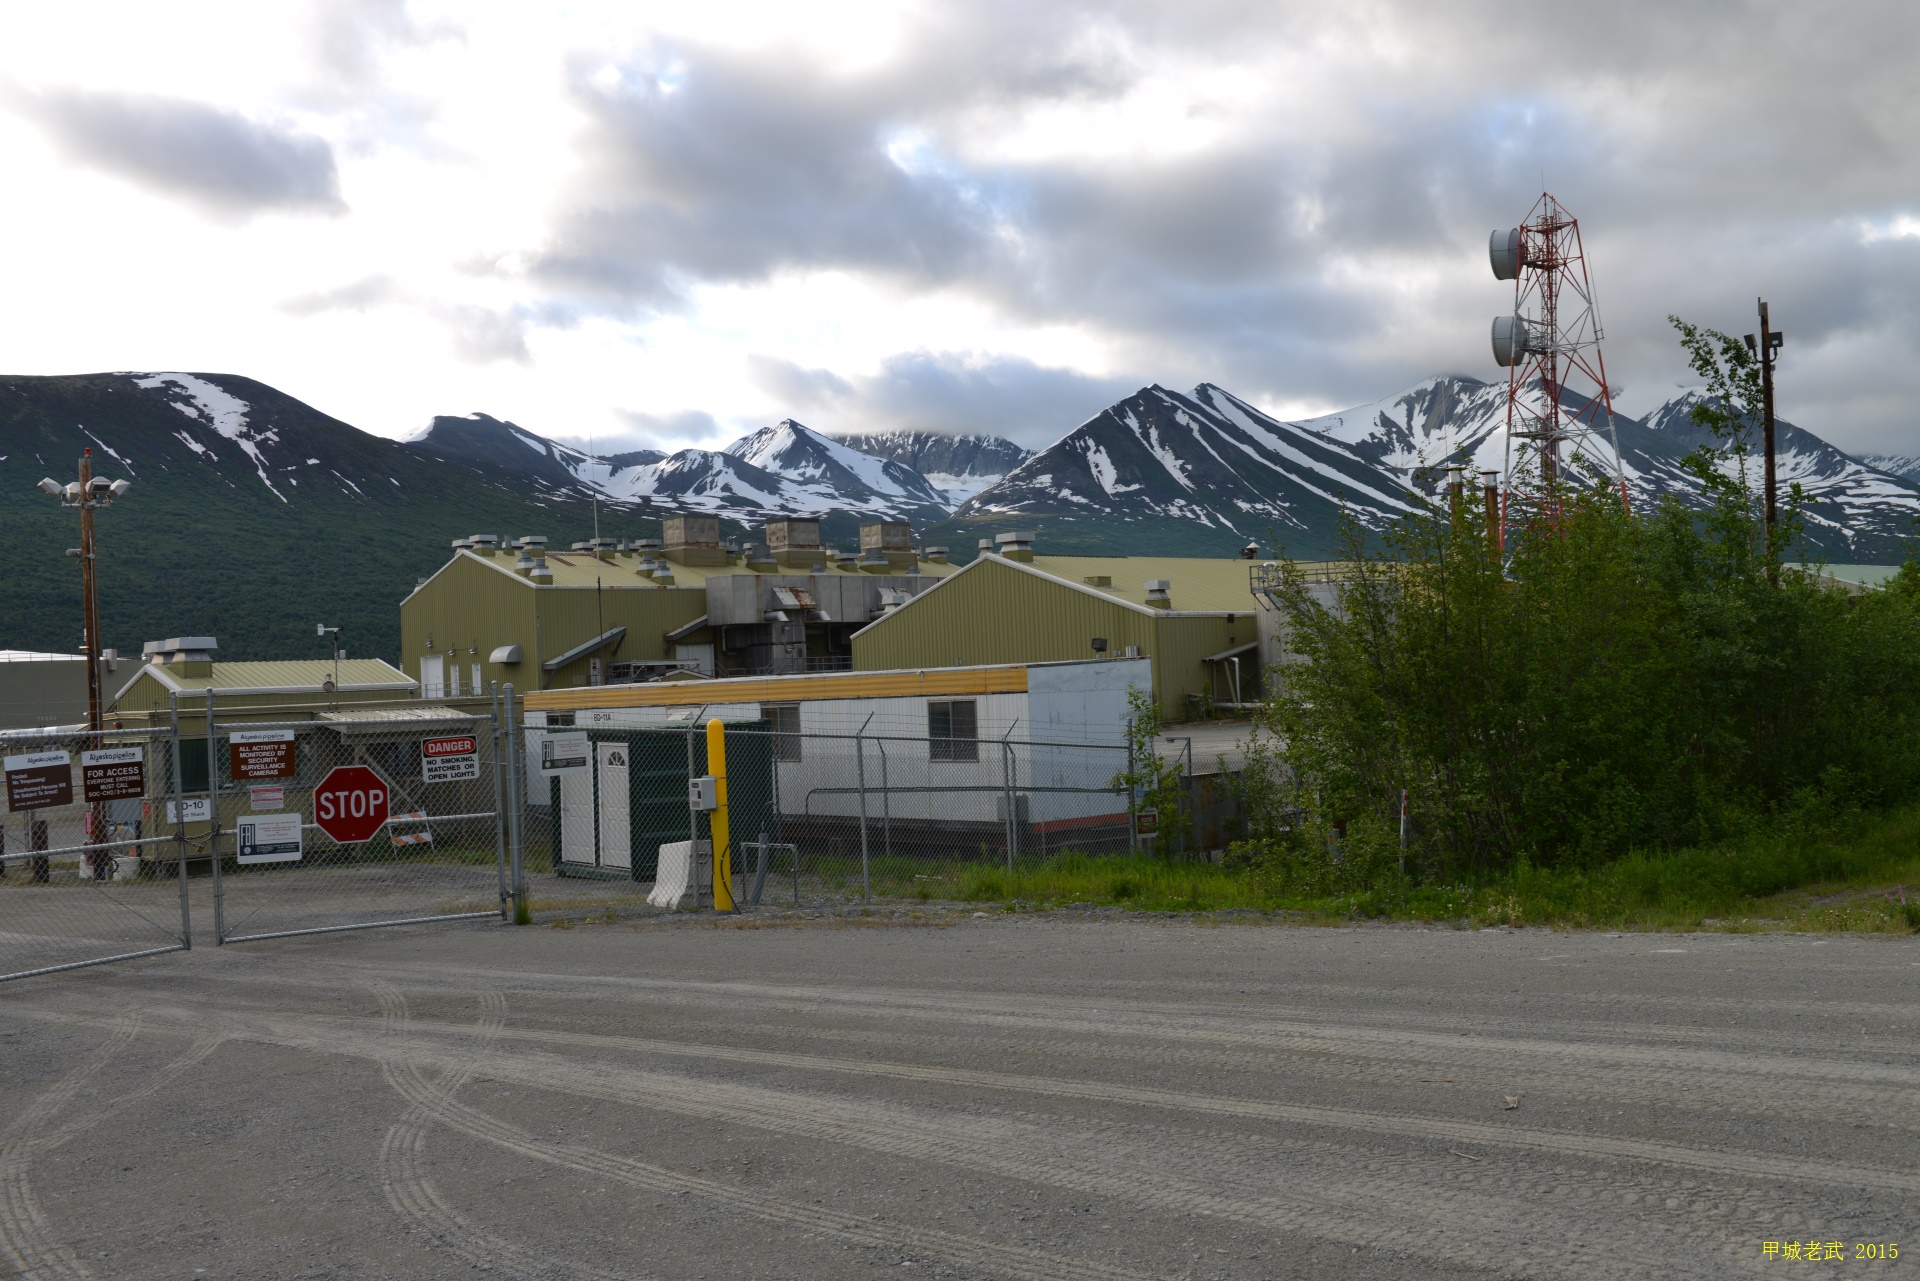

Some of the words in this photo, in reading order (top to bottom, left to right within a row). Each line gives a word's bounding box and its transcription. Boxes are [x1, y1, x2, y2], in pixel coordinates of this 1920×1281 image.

[428, 741, 471, 753] DANGER
[543, 742, 554, 760] FBI
[90, 752, 112, 762] Alyeska
[113, 750, 135, 761] pipeline
[87, 770, 104, 778] FOR
[107, 767, 139, 776] ACCESS
[175, 801, 203, 810] D-10
[320, 789, 384, 820] STOP
[240, 825, 254, 846] FBI
